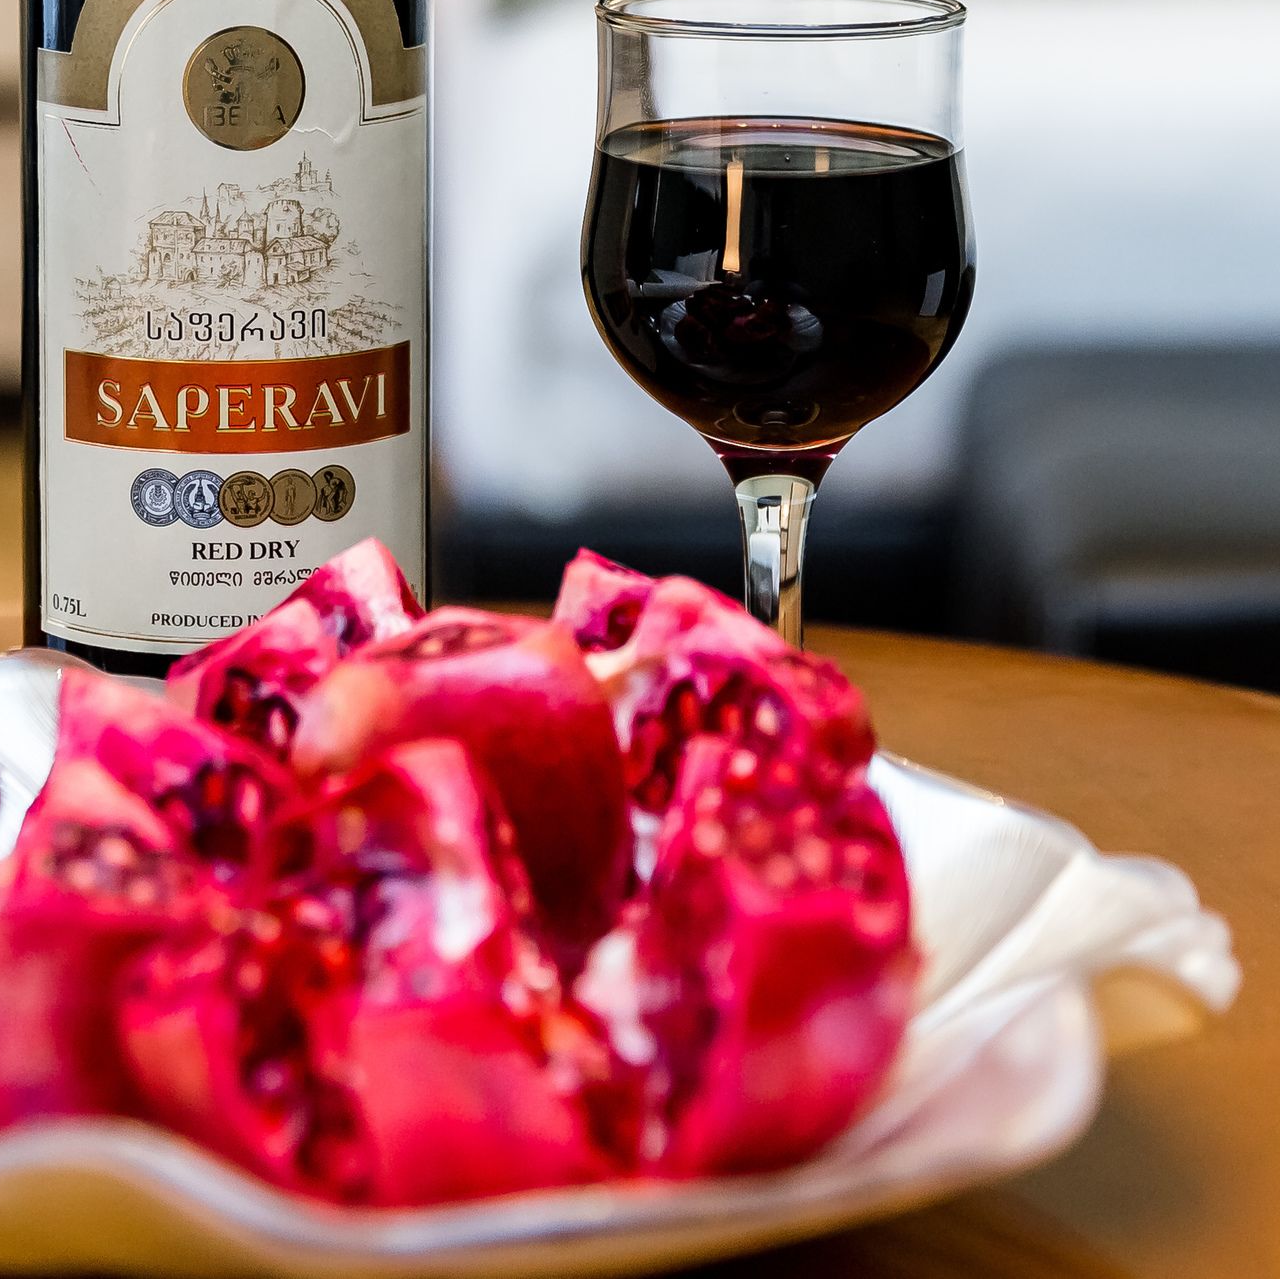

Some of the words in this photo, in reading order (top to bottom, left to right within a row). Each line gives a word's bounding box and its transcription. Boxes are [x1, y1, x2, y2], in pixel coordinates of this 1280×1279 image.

[147, 308, 327, 342] საფერავი
[96, 372, 386, 432] SAPERAVI
[191, 542, 243, 561] RED
[249, 539, 300, 560] DRY
[52, 593, 87, 617] 0.75L
[151, 613, 243, 628] PRODUCED
